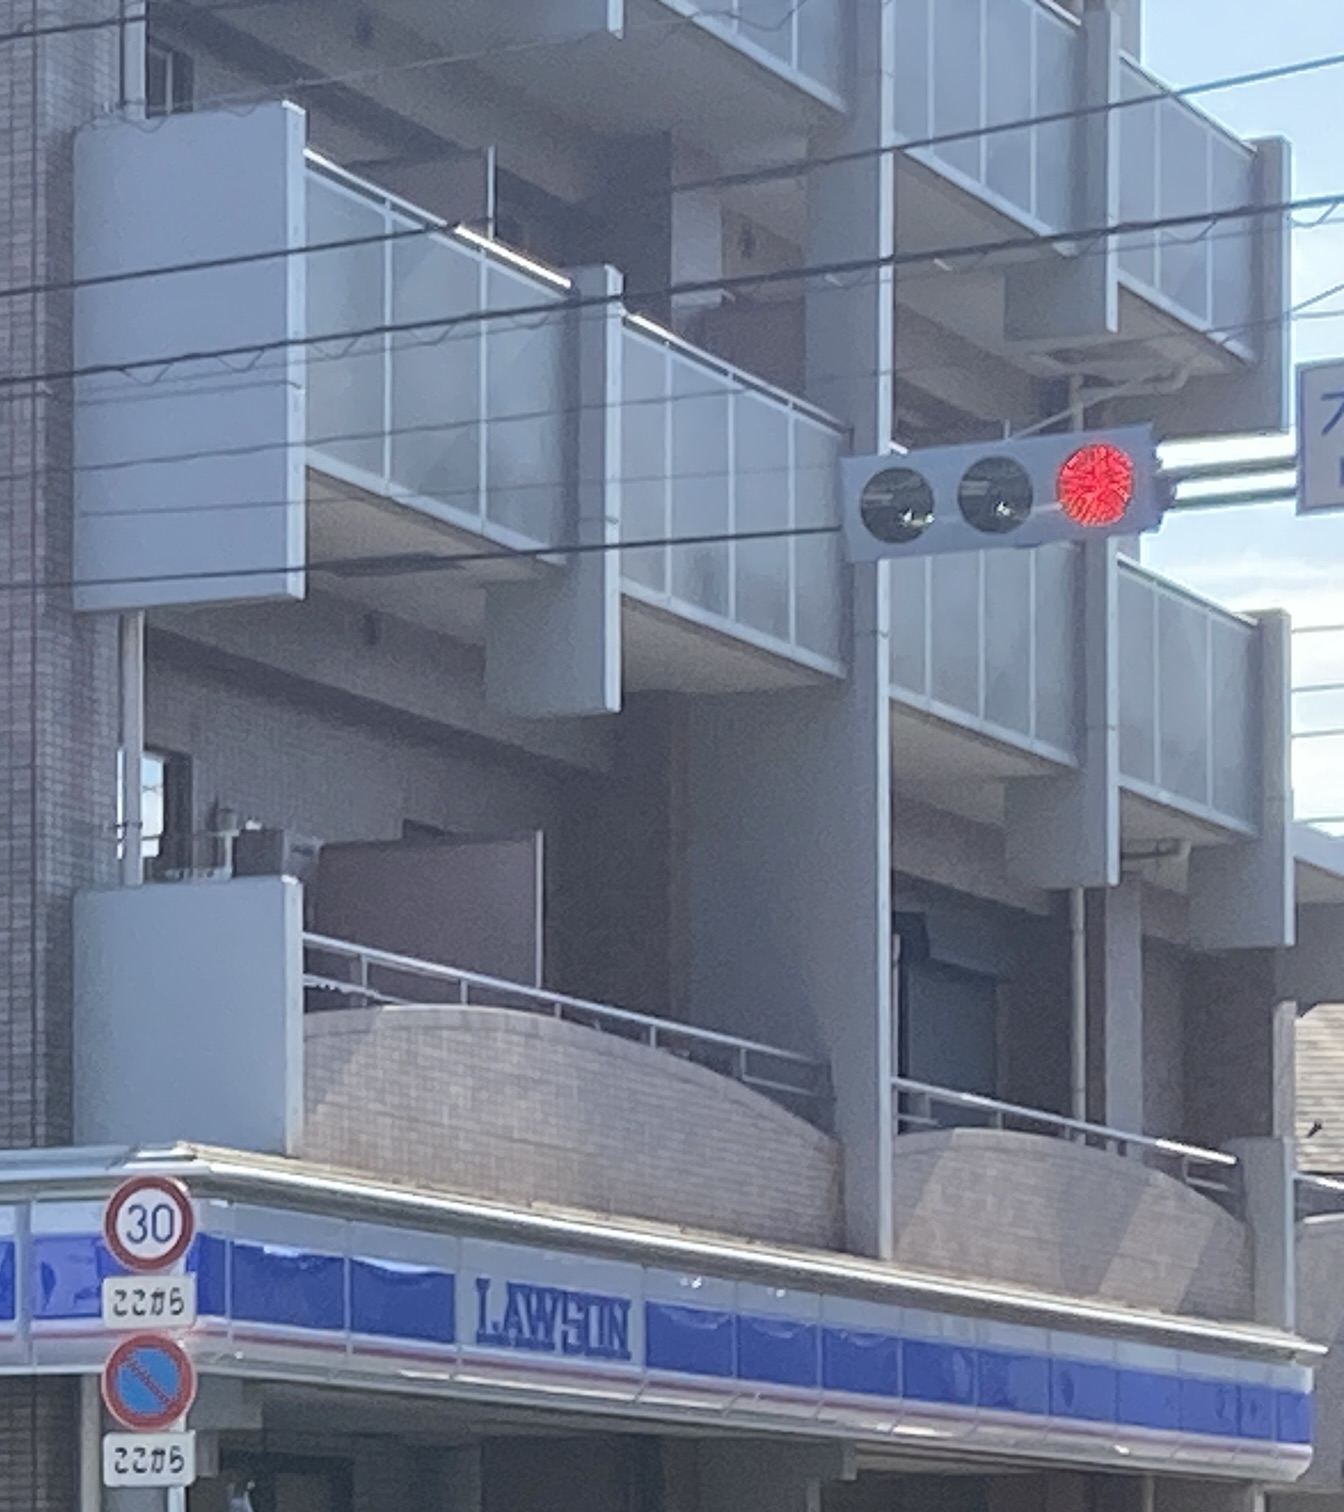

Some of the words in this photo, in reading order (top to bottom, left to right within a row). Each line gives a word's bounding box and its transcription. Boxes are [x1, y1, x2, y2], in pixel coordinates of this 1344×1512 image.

[125, 1203, 175, 1245] 30
[112, 1287, 185, 1317] ここから
[474, 1276, 632, 1361] LAWSON
[113, 1445, 185, 1475] ここから
